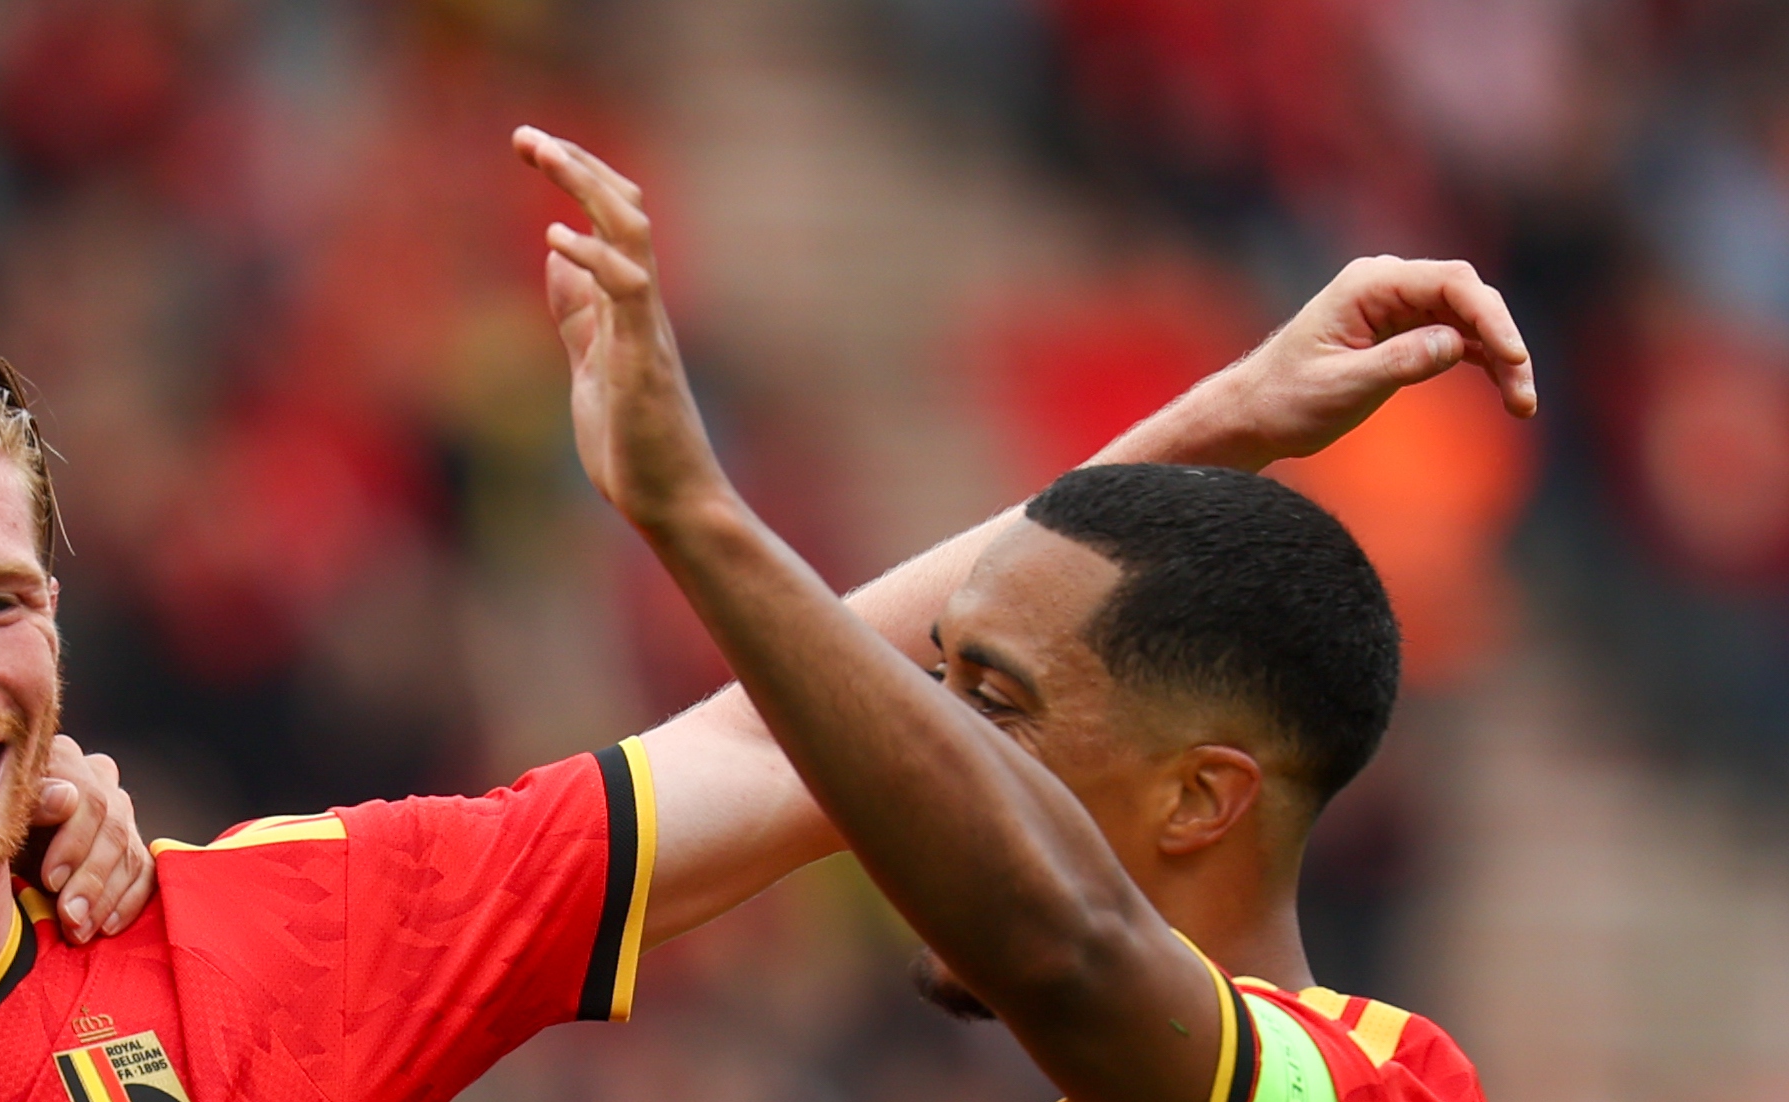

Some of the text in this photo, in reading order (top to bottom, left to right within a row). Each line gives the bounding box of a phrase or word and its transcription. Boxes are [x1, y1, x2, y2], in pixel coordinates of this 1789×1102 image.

[105, 1039, 144, 1057] ROYAL
[110, 1047, 163, 1069] BELGIAN
[138, 1058, 168, 1076] 1895
